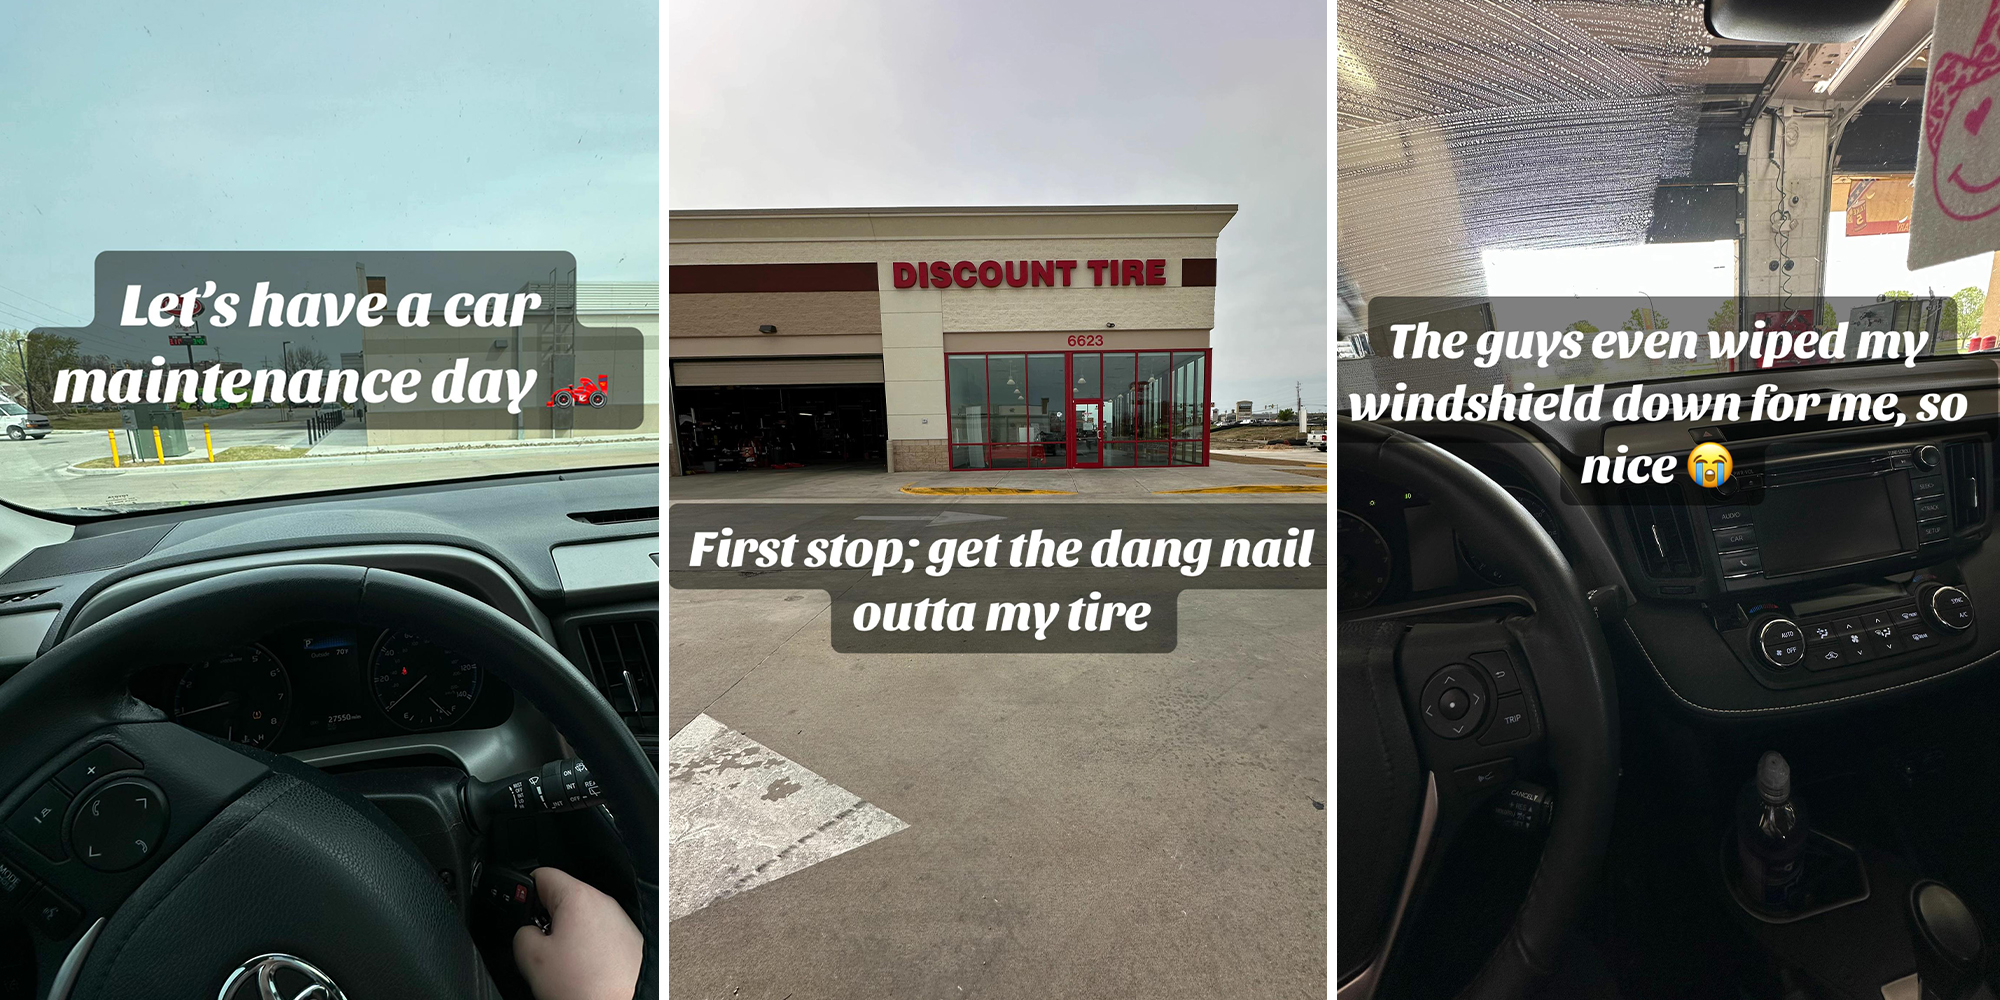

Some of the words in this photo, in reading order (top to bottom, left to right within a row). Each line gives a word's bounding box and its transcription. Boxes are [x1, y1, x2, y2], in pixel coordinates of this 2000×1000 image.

[893, 260, 1077, 289] DISCOUNT
[1087, 259, 1167, 287] TIRE
[1067, 334, 1104, 347] 6623
[1721, 511, 1741, 520] AUDIO
[1926, 527, 1941, 535] SETUP
[1730, 535, 1743, 543] CAR
[1959, 611, 1968, 619] A/C
[1781, 630, 1794, 639] AUTO
[305, 640, 311, 648] P
[385, 649, 395, 657] 40
[1786, 646, 1797, 655] OFF
[185, 681, 192, 689] 2
[328, 713, 351, 723] 27550
[1504, 713, 1522, 725] TRIP
[563, 769, 572, 777] ON
[565, 782, 576, 791] INT
[569, 795, 580, 803] OFF
[1510, 789, 1535, 801] CANCEL
[0, 864, 22, 885] MODE
